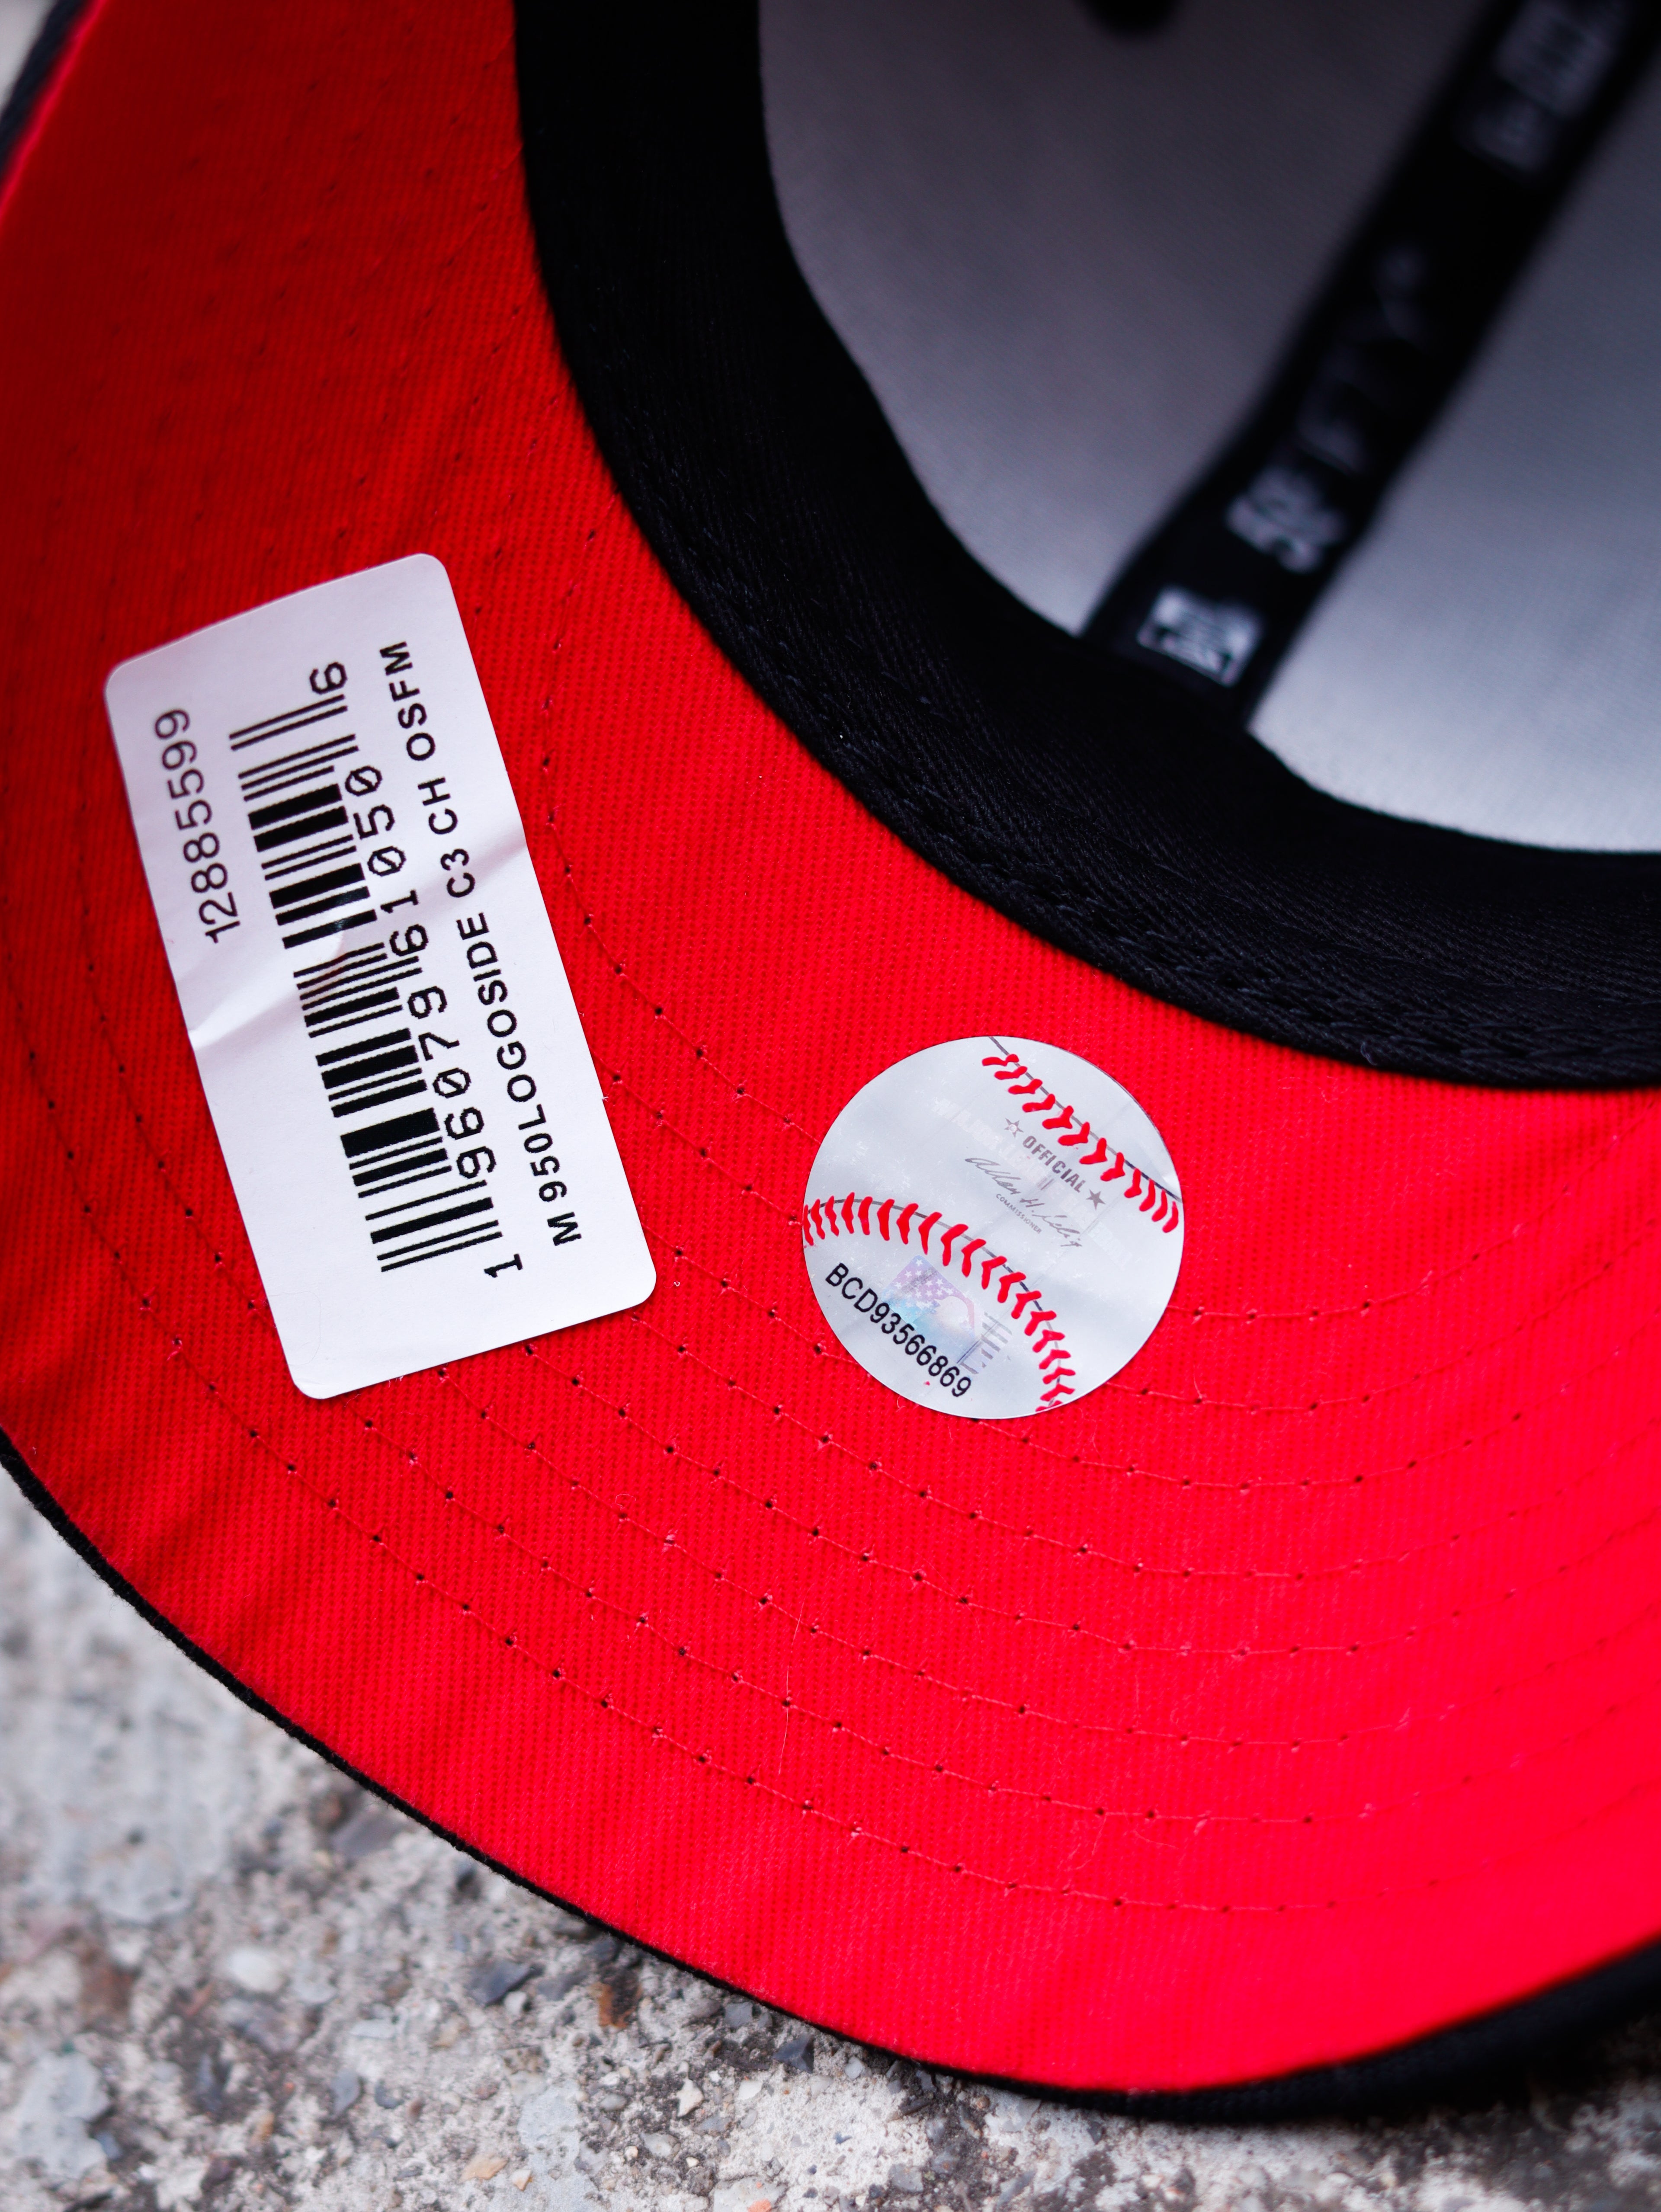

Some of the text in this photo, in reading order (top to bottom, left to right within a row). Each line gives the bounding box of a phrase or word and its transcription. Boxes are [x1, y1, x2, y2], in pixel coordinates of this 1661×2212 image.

[154, 709, 240, 944] 12885599
[309, 662, 523, 1278] 1 96079 61050 6
[379, 642, 582, 1246] M 950LOGOSIDE C3 CH OSFM
[996, 1194, 1042, 1234] COMMISSIONER
[1023, 1135, 1086, 1193] OFFICIAL
[825, 1263, 972, 1397] BCD93566869
